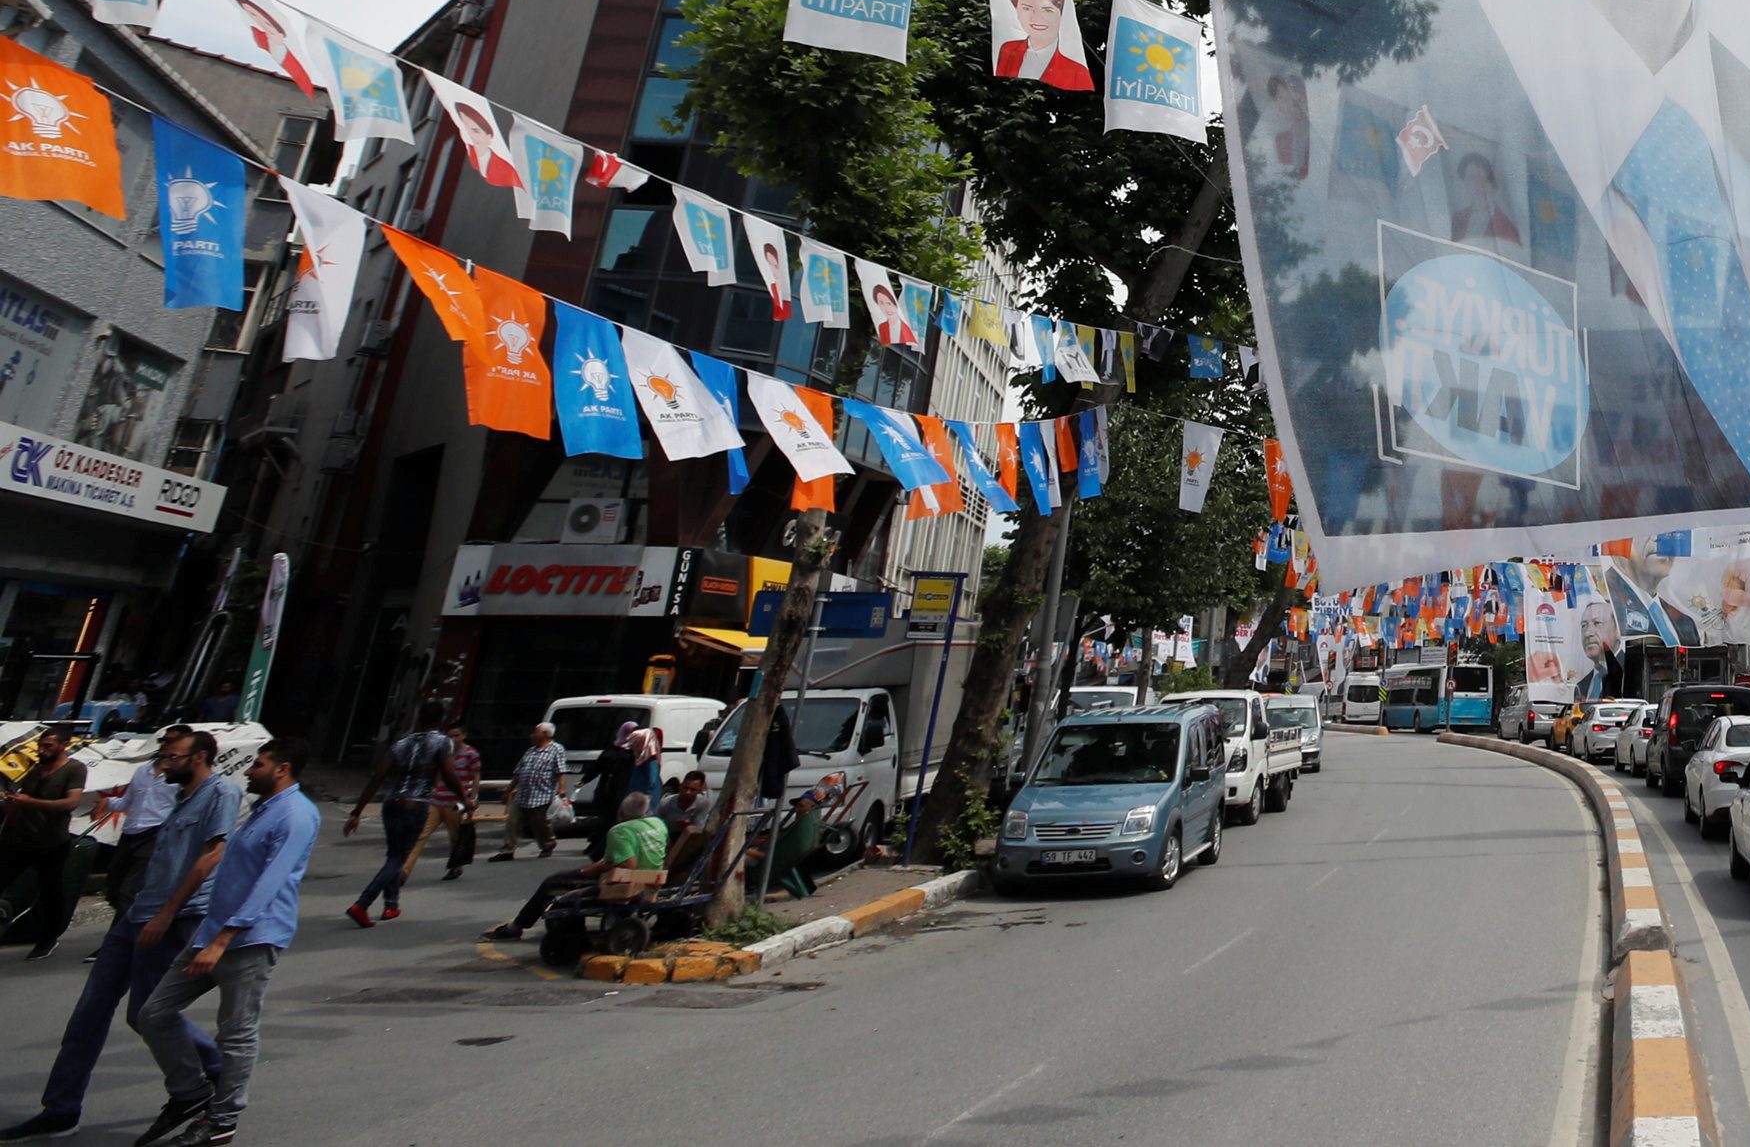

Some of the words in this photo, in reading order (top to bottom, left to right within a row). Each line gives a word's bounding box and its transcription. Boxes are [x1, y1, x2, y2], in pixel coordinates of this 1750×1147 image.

[7, 141, 34, 153] AK
[583, 405, 598, 413] AK
[485, 564, 636, 596] LOCTITE
